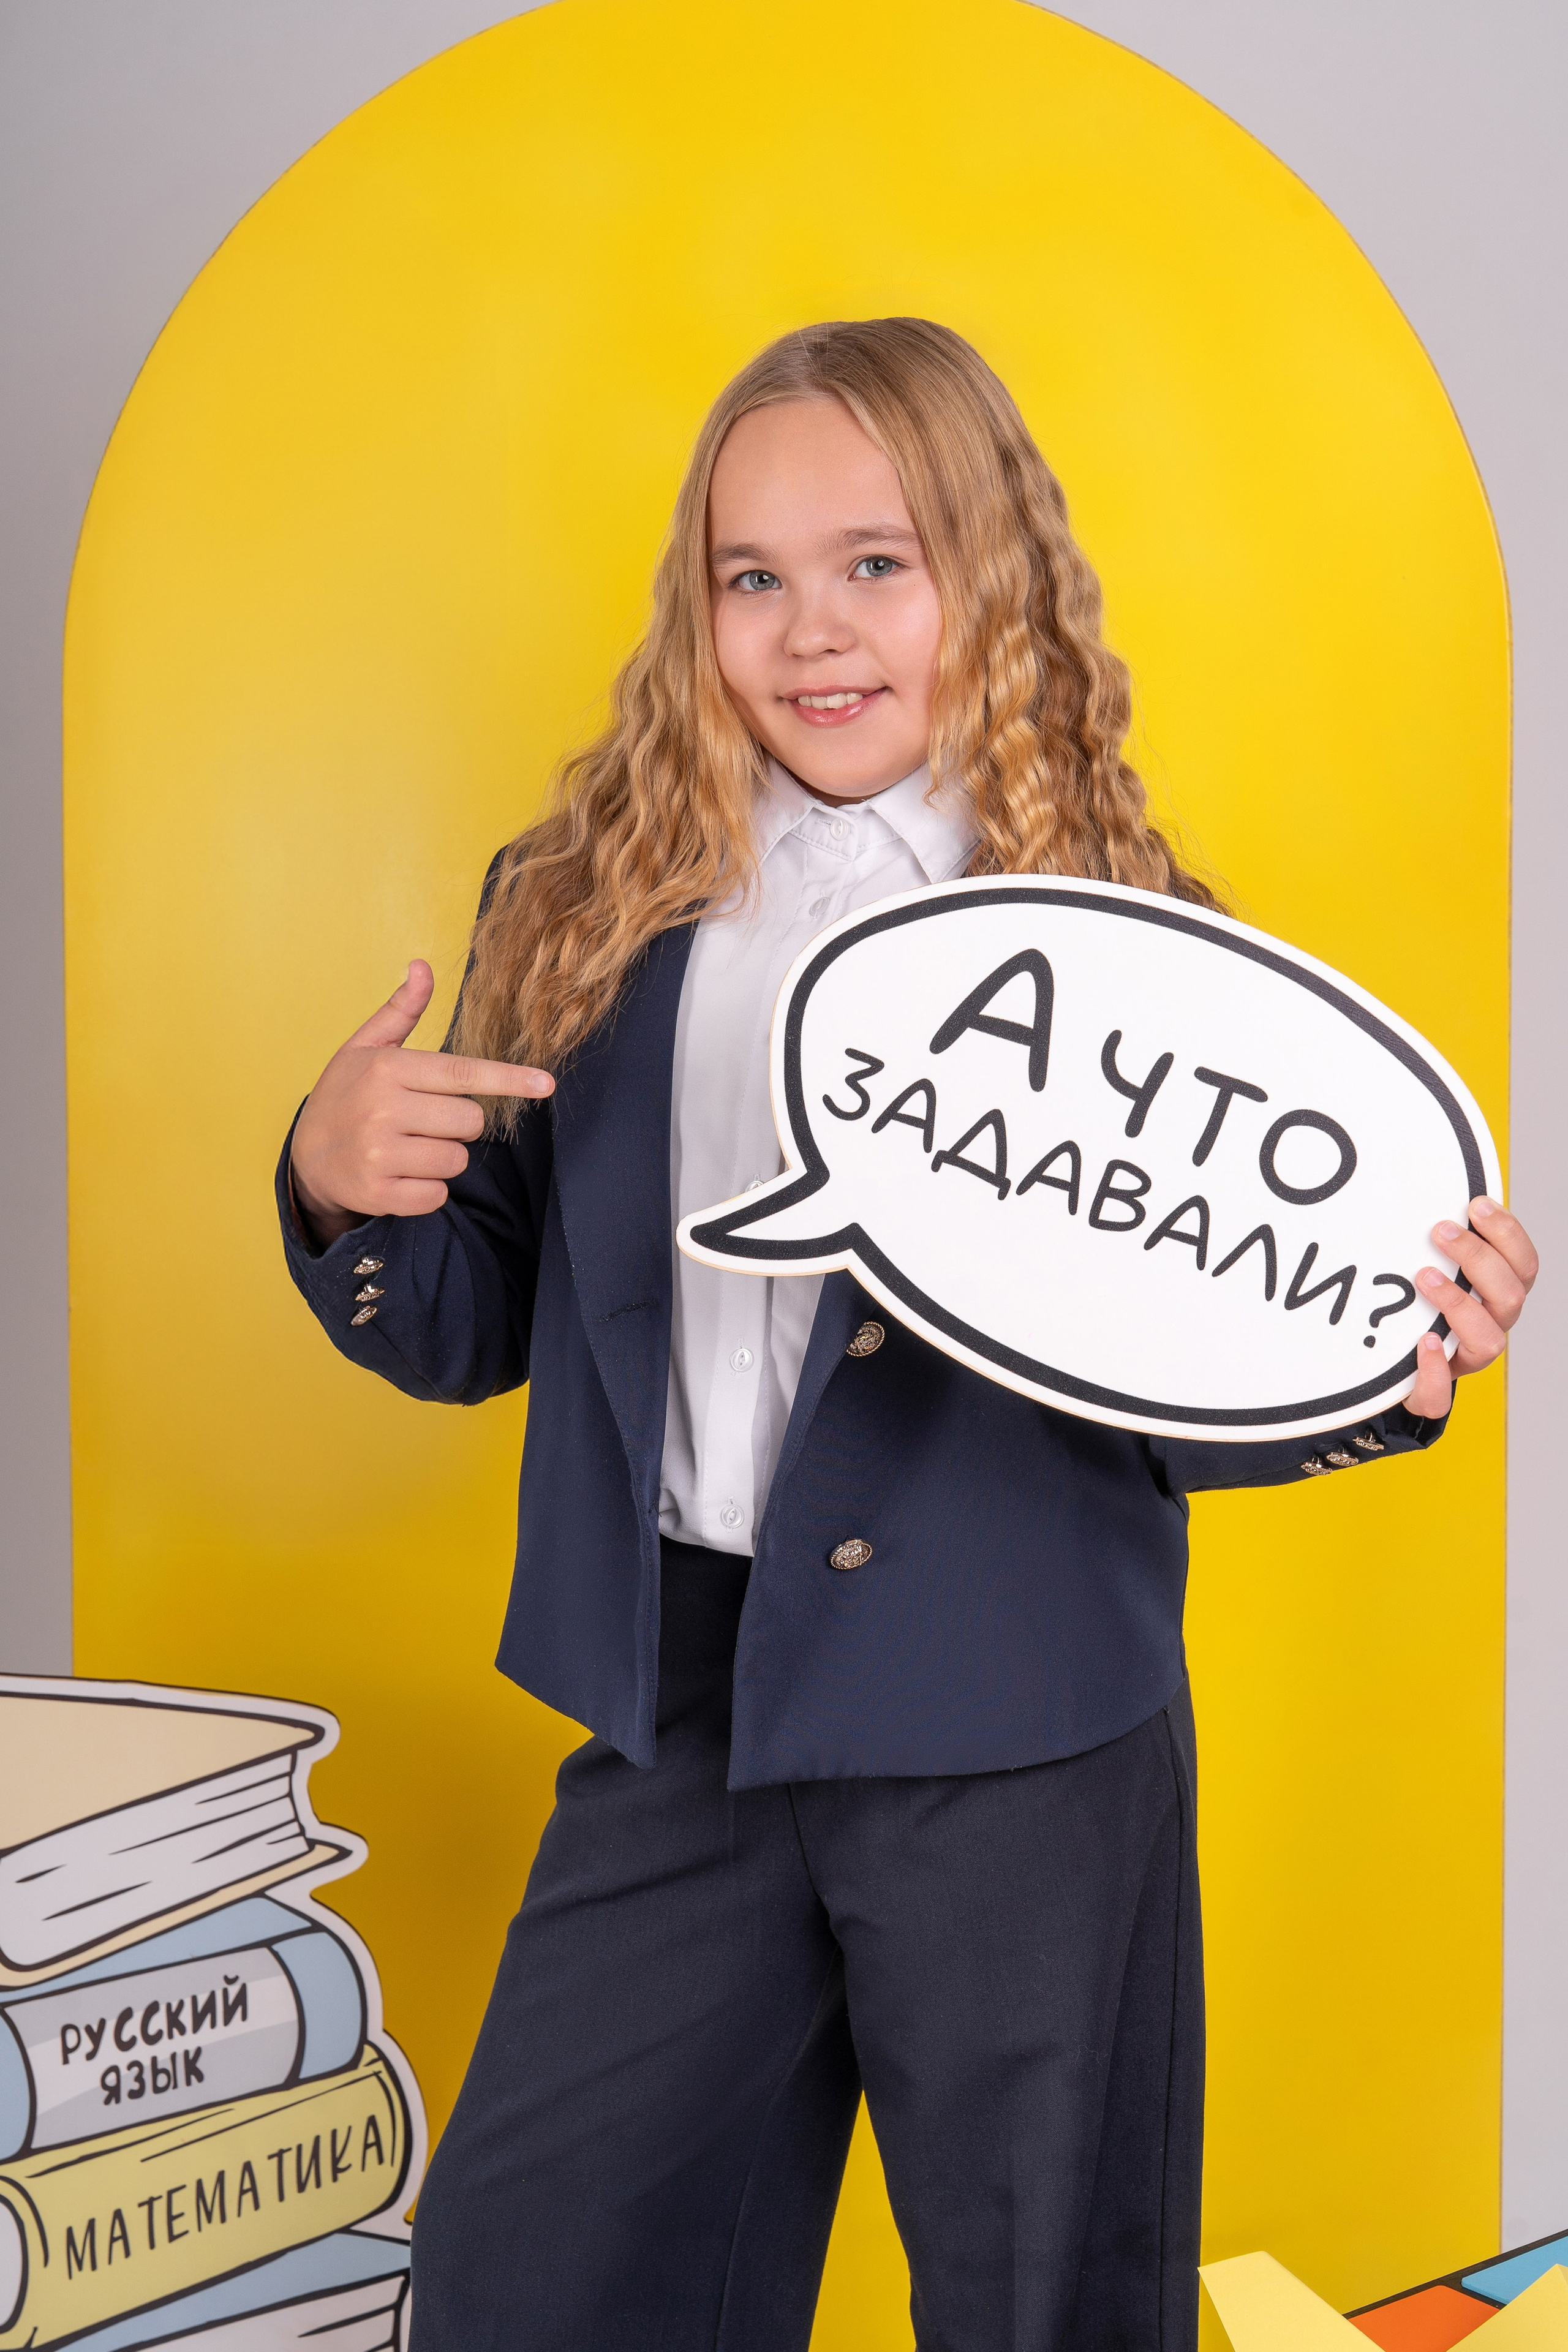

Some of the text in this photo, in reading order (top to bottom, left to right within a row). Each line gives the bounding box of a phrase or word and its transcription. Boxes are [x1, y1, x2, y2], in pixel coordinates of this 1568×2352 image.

[929, 948, 1357, 1205] А ЧТО
[822, 1048, 1416, 1349] ЗАДАВАЛИ?
[60, 1975, 248, 2065] РУССКИЙ
[100, 2046, 205, 2106] ЯЗЫК
[66, 2114, 385, 2280] МАТЕМАТИКА
